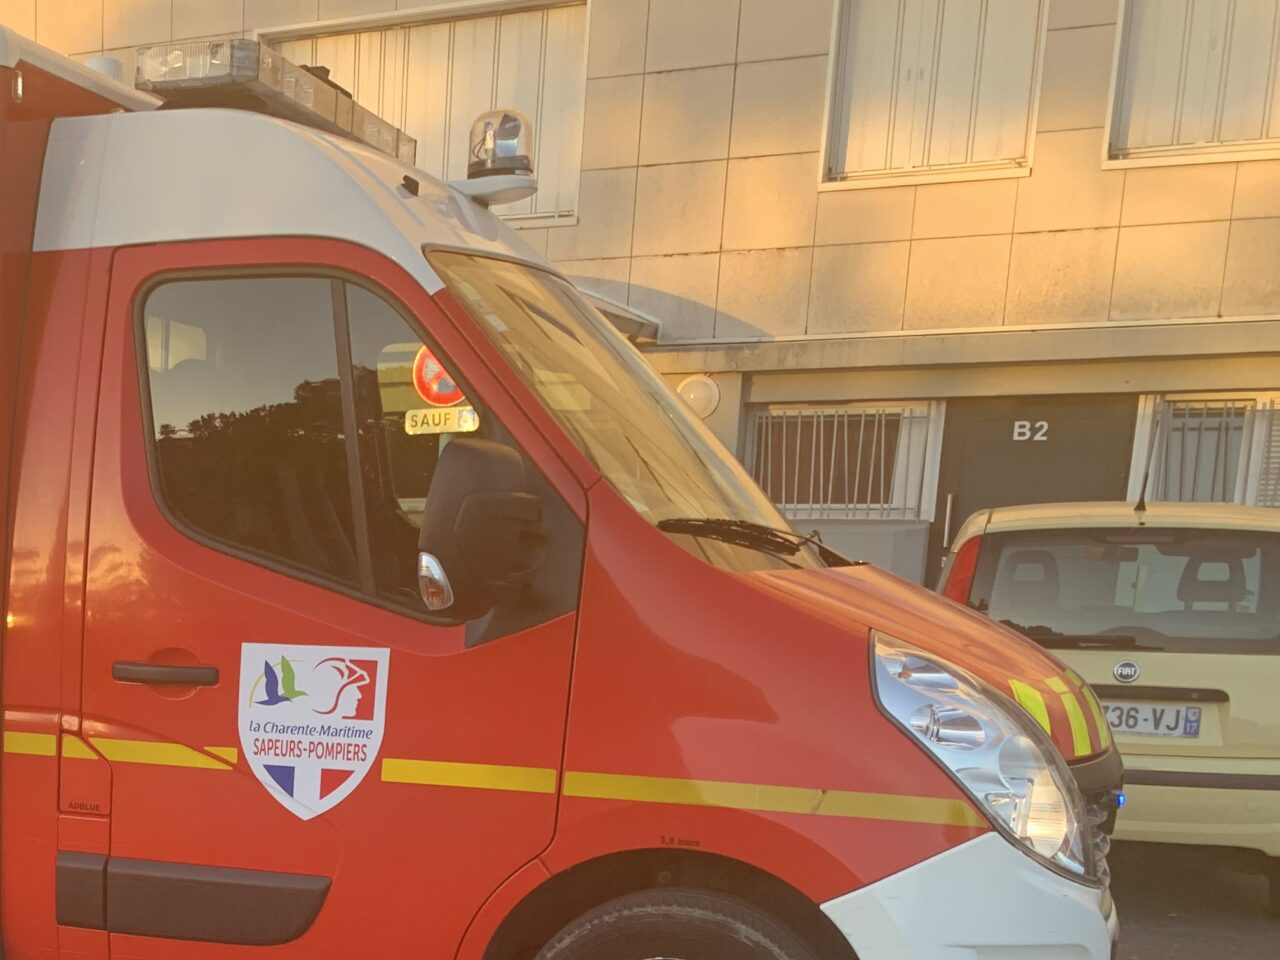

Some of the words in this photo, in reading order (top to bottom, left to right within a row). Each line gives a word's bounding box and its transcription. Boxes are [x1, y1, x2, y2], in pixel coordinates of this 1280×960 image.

[410, 412, 451, 428] SAUF
[1013, 420, 1049, 441] B2
[1117, 667, 1137, 676] FIAT
[249, 719, 261, 732] la
[263, 721, 373, 740] Charente-Maritime
[1186, 722, 1198, 734] 17
[253, 737, 368, 763] SAPEURS-POMPIERS
